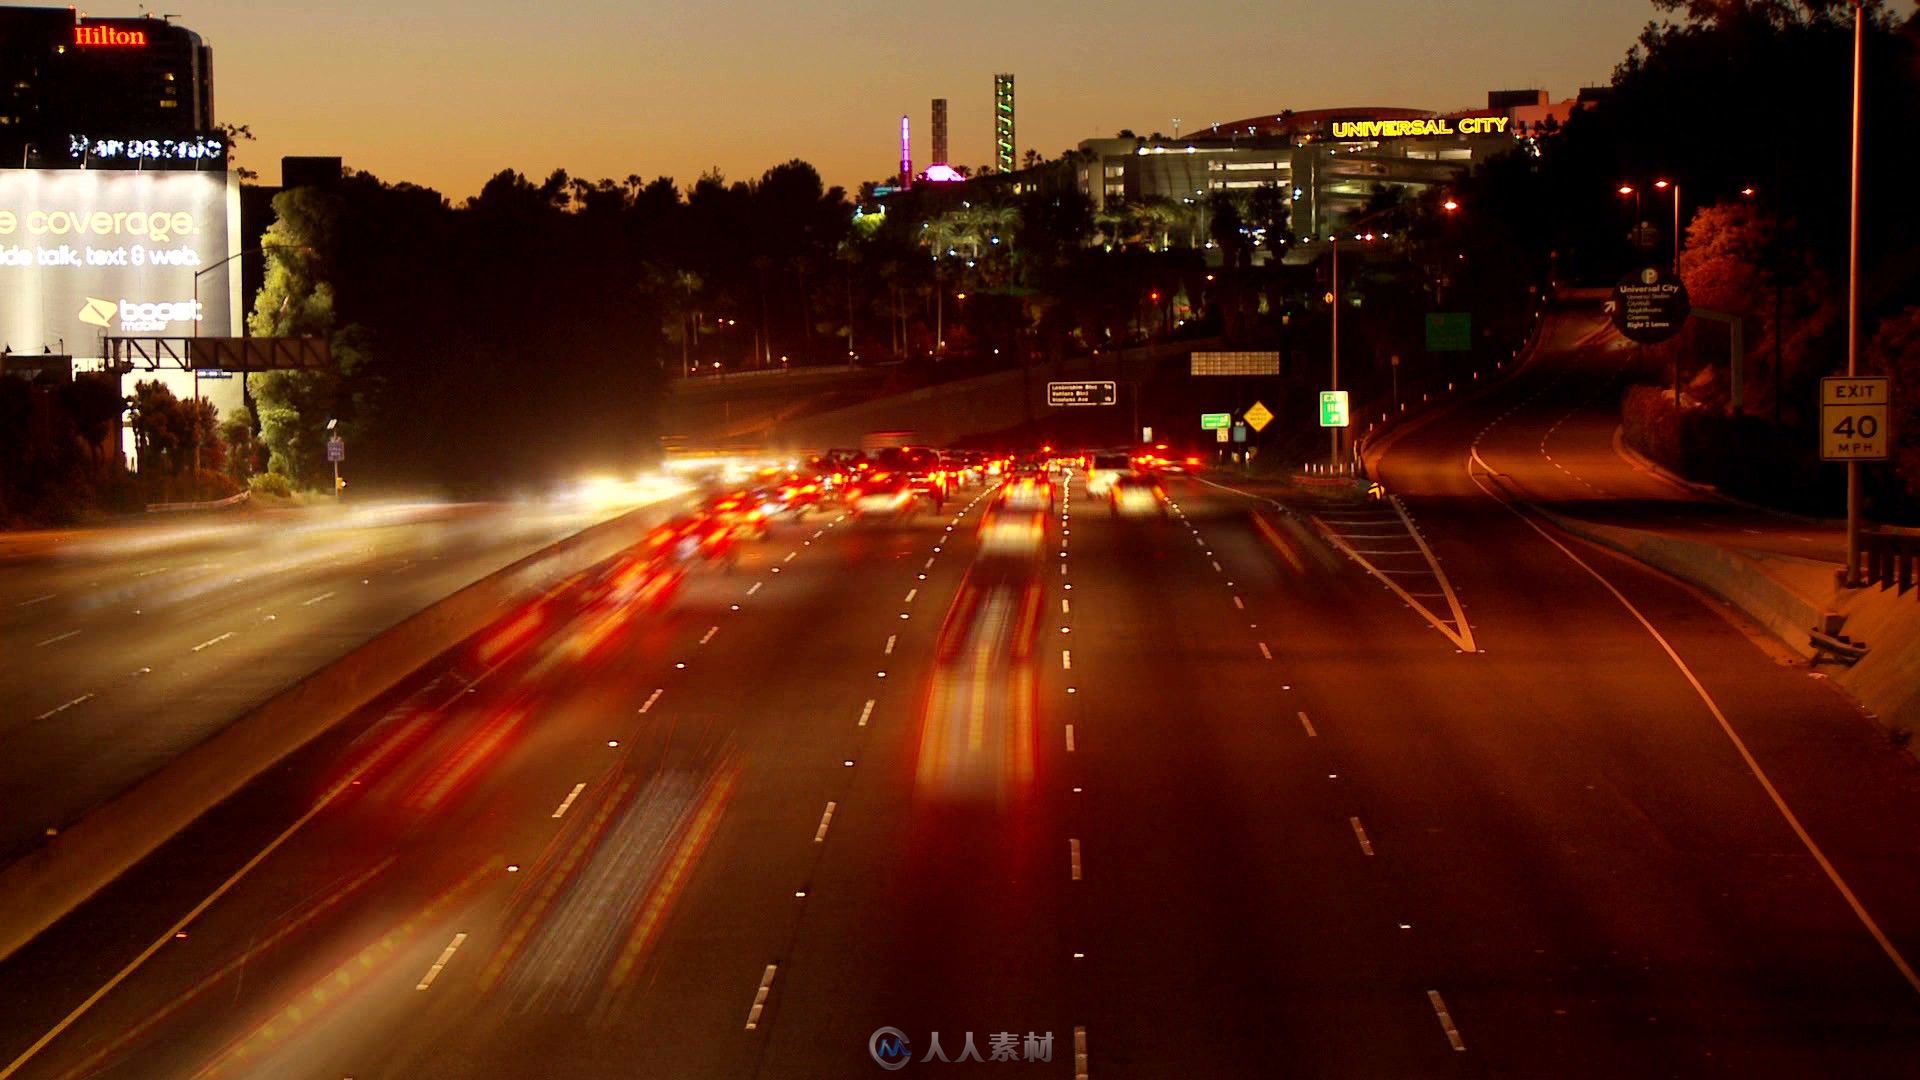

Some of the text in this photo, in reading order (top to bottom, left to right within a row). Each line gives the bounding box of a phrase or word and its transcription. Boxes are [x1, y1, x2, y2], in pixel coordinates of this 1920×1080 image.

[74, 25, 146, 45] Hilton
[1332, 116, 1510, 138] UNIVERSAL CITY
[26, 209, 201, 242] coverage.
[86, 245, 128, 266] text
[1620, 284, 1679, 294] Universal City
[1835, 385, 1875, 398] EXIT
[1831, 415, 1878, 439] 40
[1838, 442, 1873, 453] MPH
